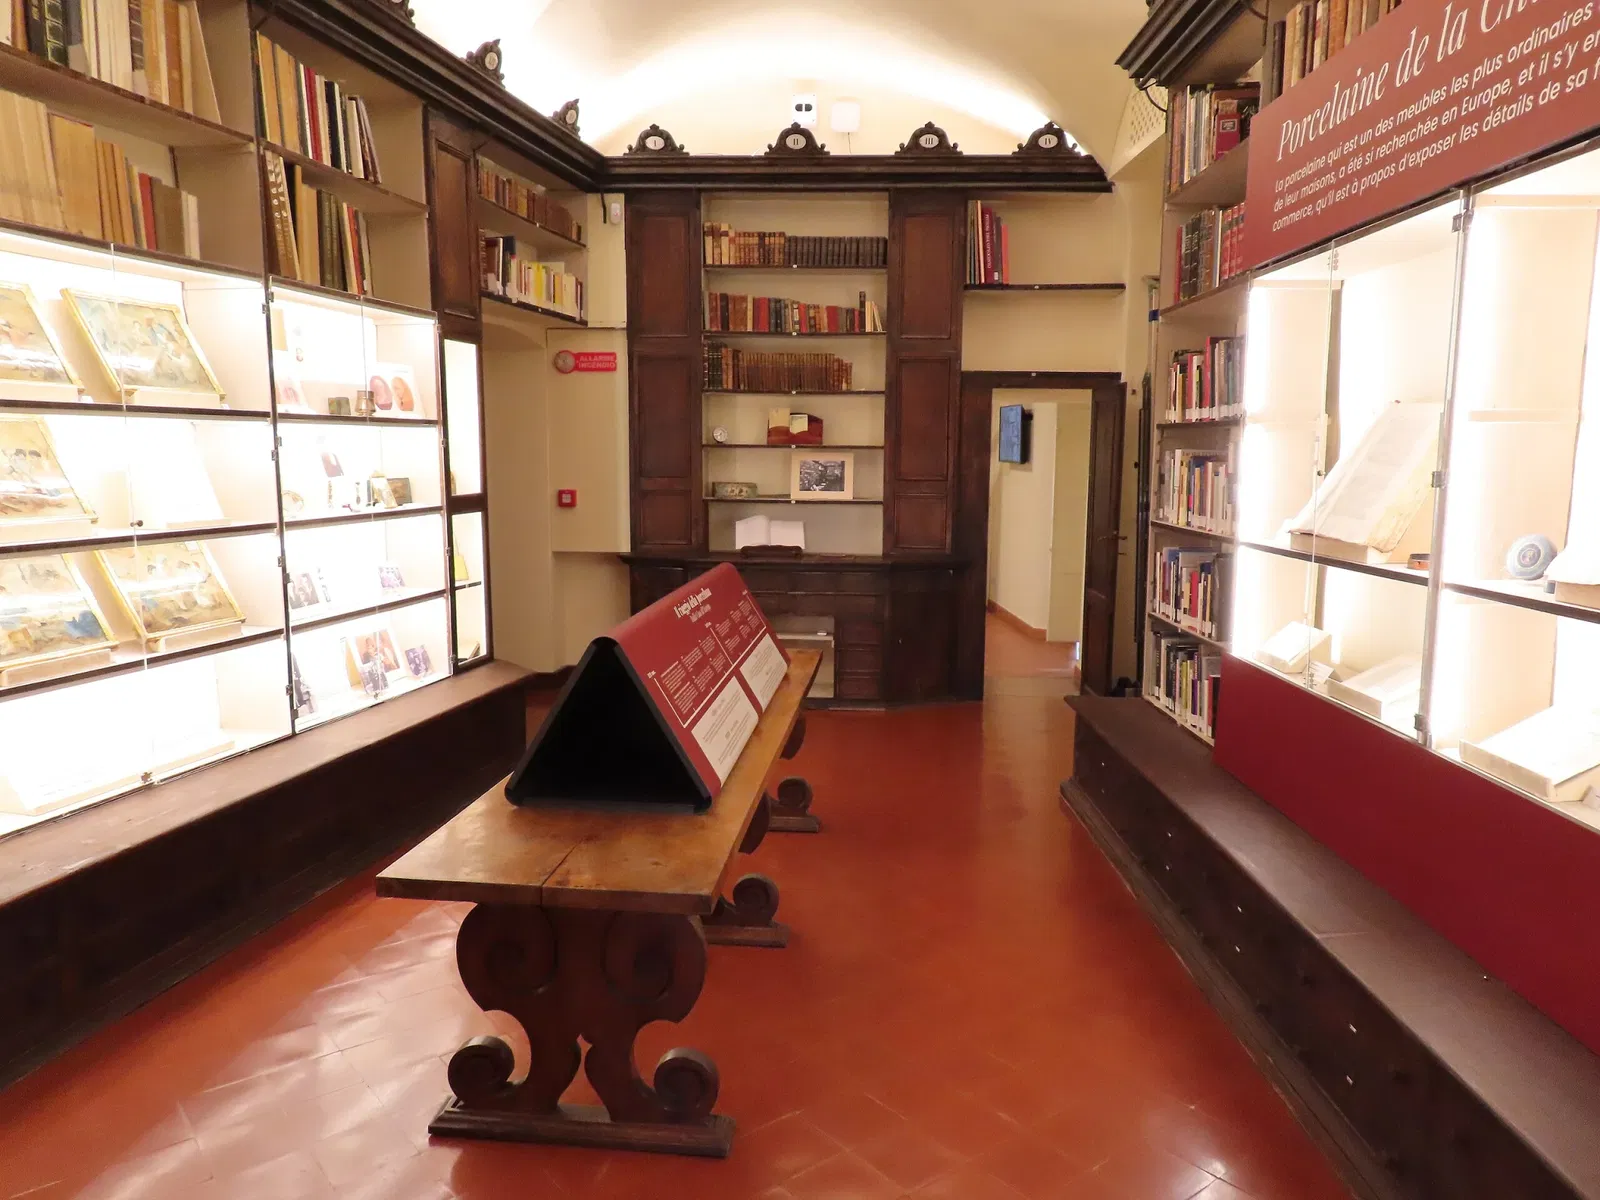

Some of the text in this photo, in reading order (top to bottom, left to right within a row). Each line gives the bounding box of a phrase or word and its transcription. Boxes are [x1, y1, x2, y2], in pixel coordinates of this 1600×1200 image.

[1272, 204, 1313, 232] commerce,
[1335, 182, 1350, 202] est
[1351, 178, 1359, 194] à
[1360, 162, 1396, 196] propos
[1459, 121, 1479, 144] les
[1482, 93, 1534, 132] détails
[1539, 80, 1561, 105] de
[1565, 67, 1589, 93] sa
[1274, 197, 1283, 212] de
[1284, 190, 1300, 207] leur
[1300, 171, 1337, 198] maisons,
[1338, 166, 1346, 179] a
[1347, 152, 1363, 174] été
[1365, 146, 1374, 166] si
[1375, 115, 1438, 160] recherchée
[1441, 105, 1458, 126] en
[1461, 78, 1512, 116] Europe,
[1518, 61, 1535, 86] et
[1538, 52, 1550, 76] il
[1276, 62, 1389, 162] Porcelaine
[1396, 26, 1429, 87] de
[1437, 2, 1468, 62] la
[1284, 155, 1326, 192] porcelaine
[1327, 143, 1342, 167] qui
[1343, 134, 1358, 155] est
[1360, 129, 1373, 146] un
[1375, 116, 1394, 137] des
[1396, 85, 1447, 125] meubles
[1450, 73, 1470, 96] les
[1471, 53, 1503, 90] plus
[1507, 2, 1593, 63] ordinaires
